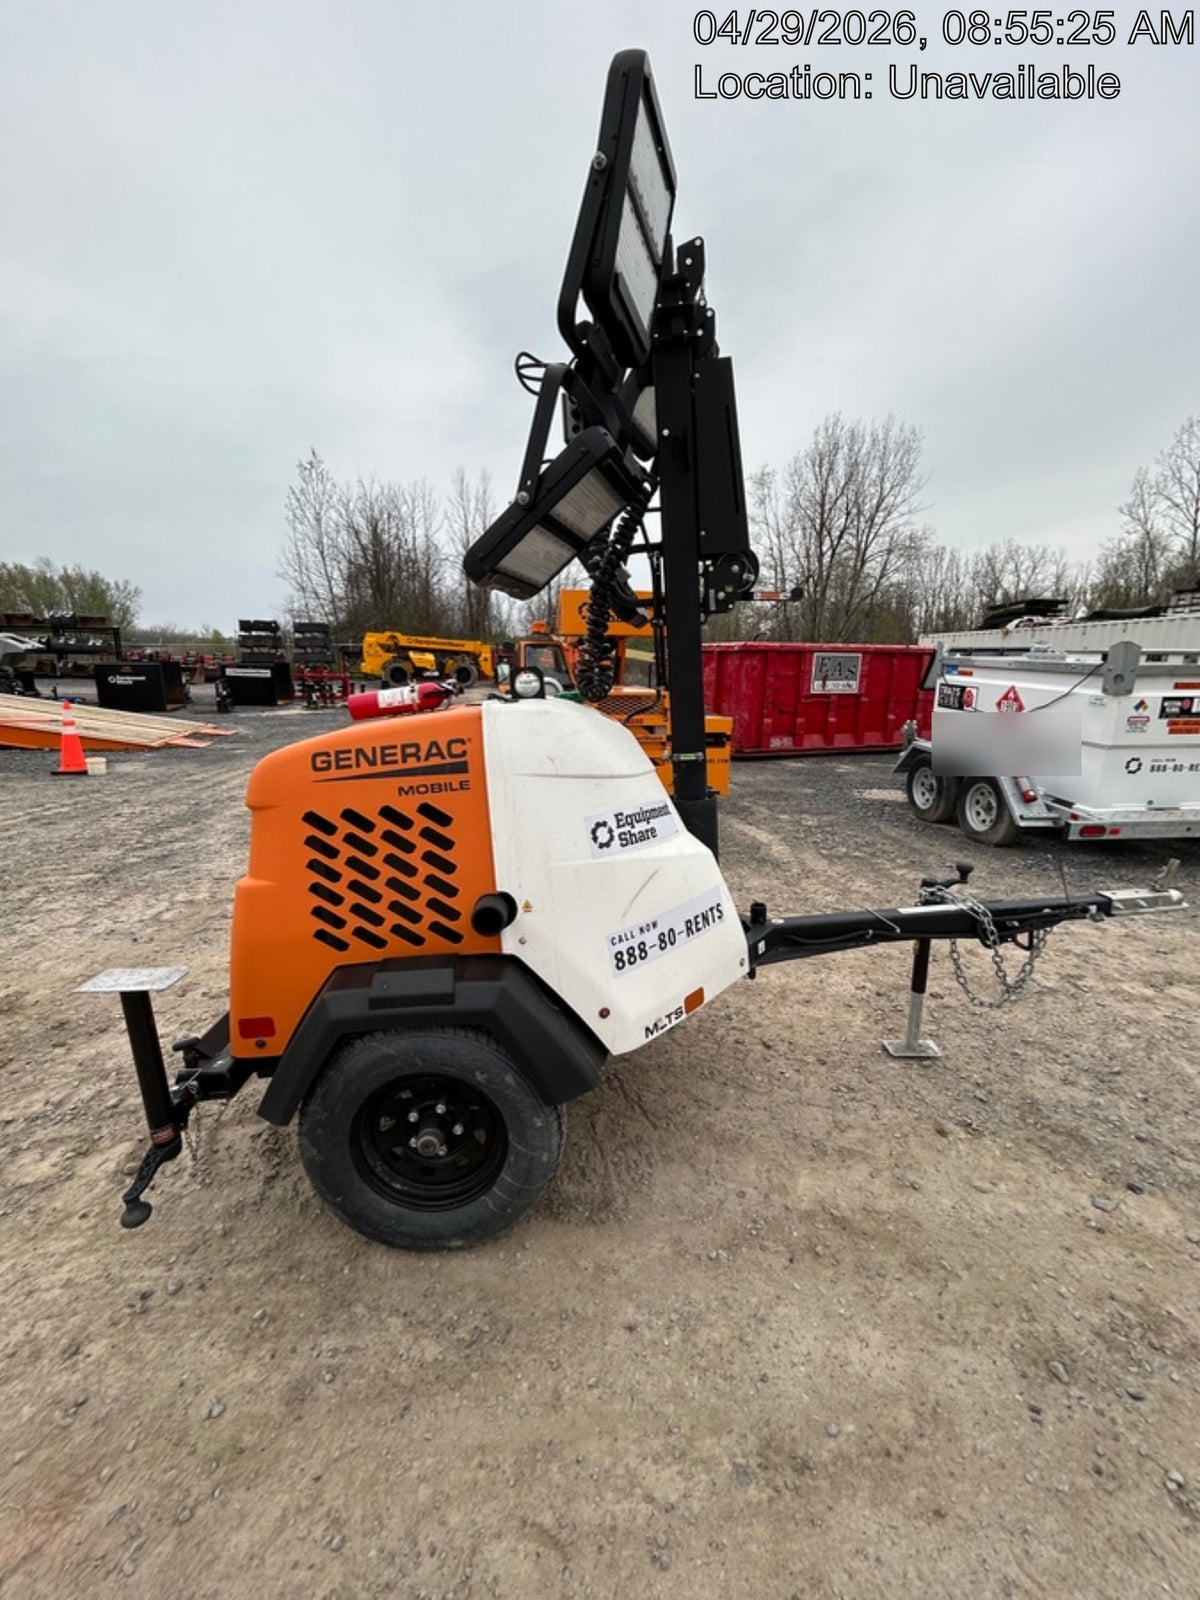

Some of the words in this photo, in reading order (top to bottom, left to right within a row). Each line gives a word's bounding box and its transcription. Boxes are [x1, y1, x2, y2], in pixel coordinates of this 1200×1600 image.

[311, 738, 468, 772] GENERAC
[398, 780, 471, 797] MOBILE
[613, 803, 672, 829] Equipment
[618, 826, 658, 848] Share
[610, 930, 636, 946] CALL
[639, 920, 659, 936] NOW
[613, 902, 724, 971] 888-80-RENTS
